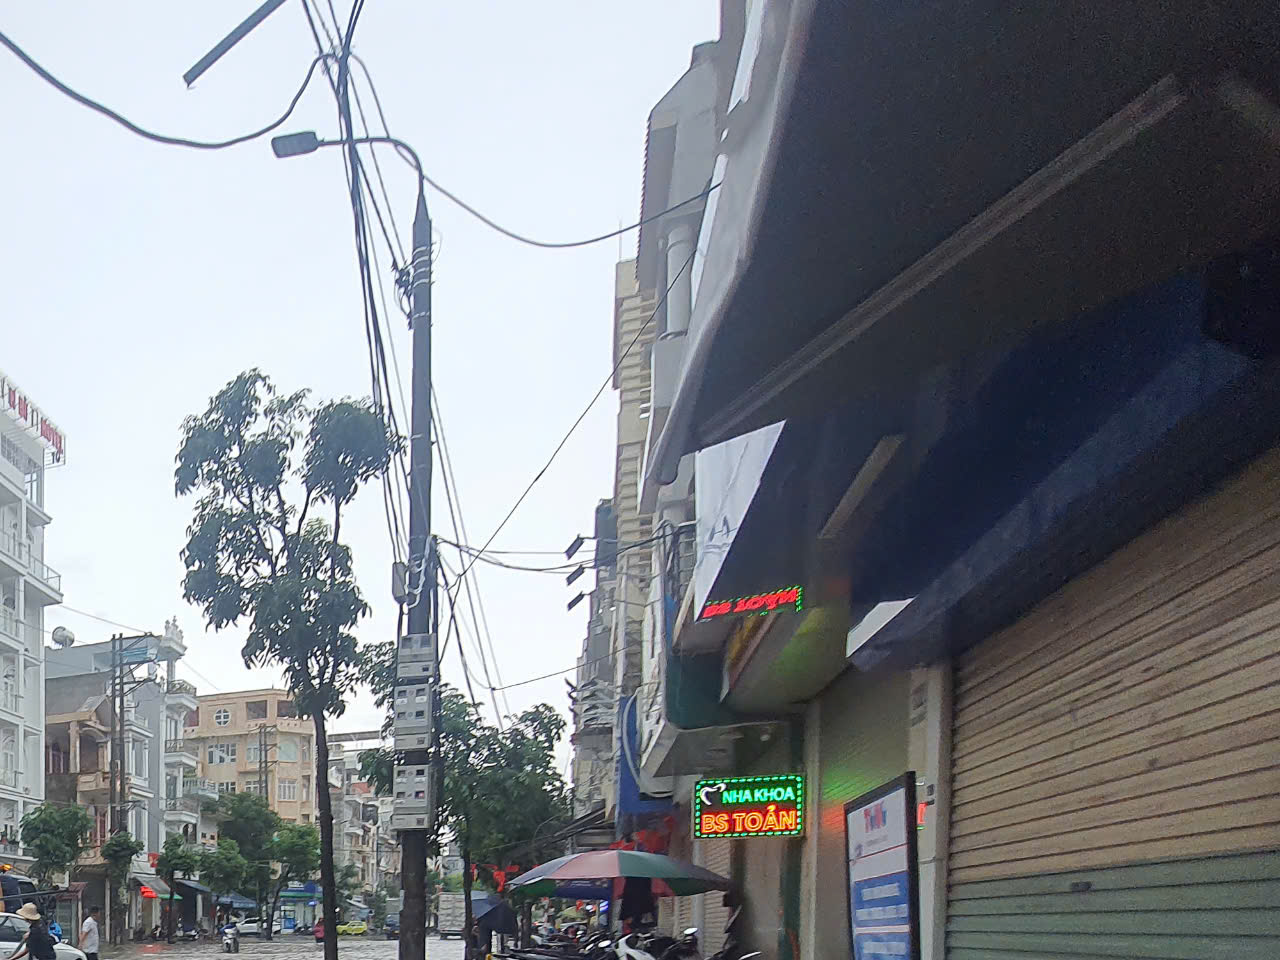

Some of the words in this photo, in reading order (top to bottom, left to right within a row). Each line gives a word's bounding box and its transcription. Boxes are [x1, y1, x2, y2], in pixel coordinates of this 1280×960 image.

[722, 789, 753, 804] NHA
[754, 786, 796, 802] KHOA
[701, 813, 729, 834] BS
[732, 803, 797, 832] TOẢN
